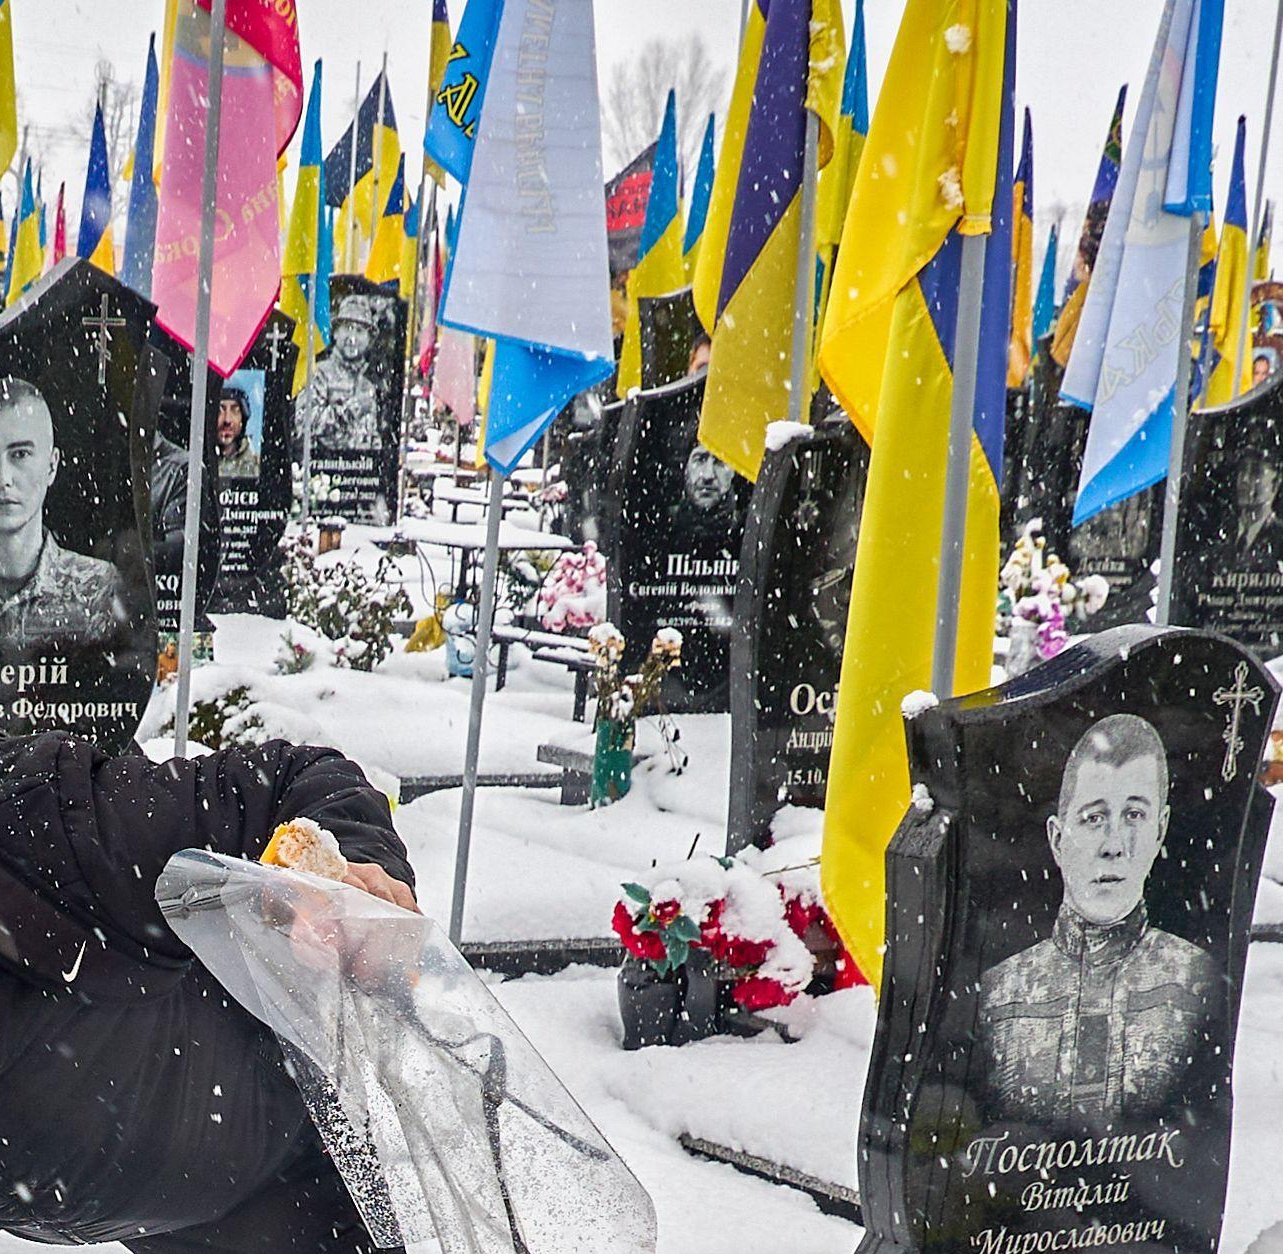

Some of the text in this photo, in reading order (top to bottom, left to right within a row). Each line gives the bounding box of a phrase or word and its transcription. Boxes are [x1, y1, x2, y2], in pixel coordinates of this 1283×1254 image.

[12, 698, 140, 724] Федорович
[962, 1129, 1185, 1178] Посполітак
[1020, 1174, 1131, 1213] Віталій
